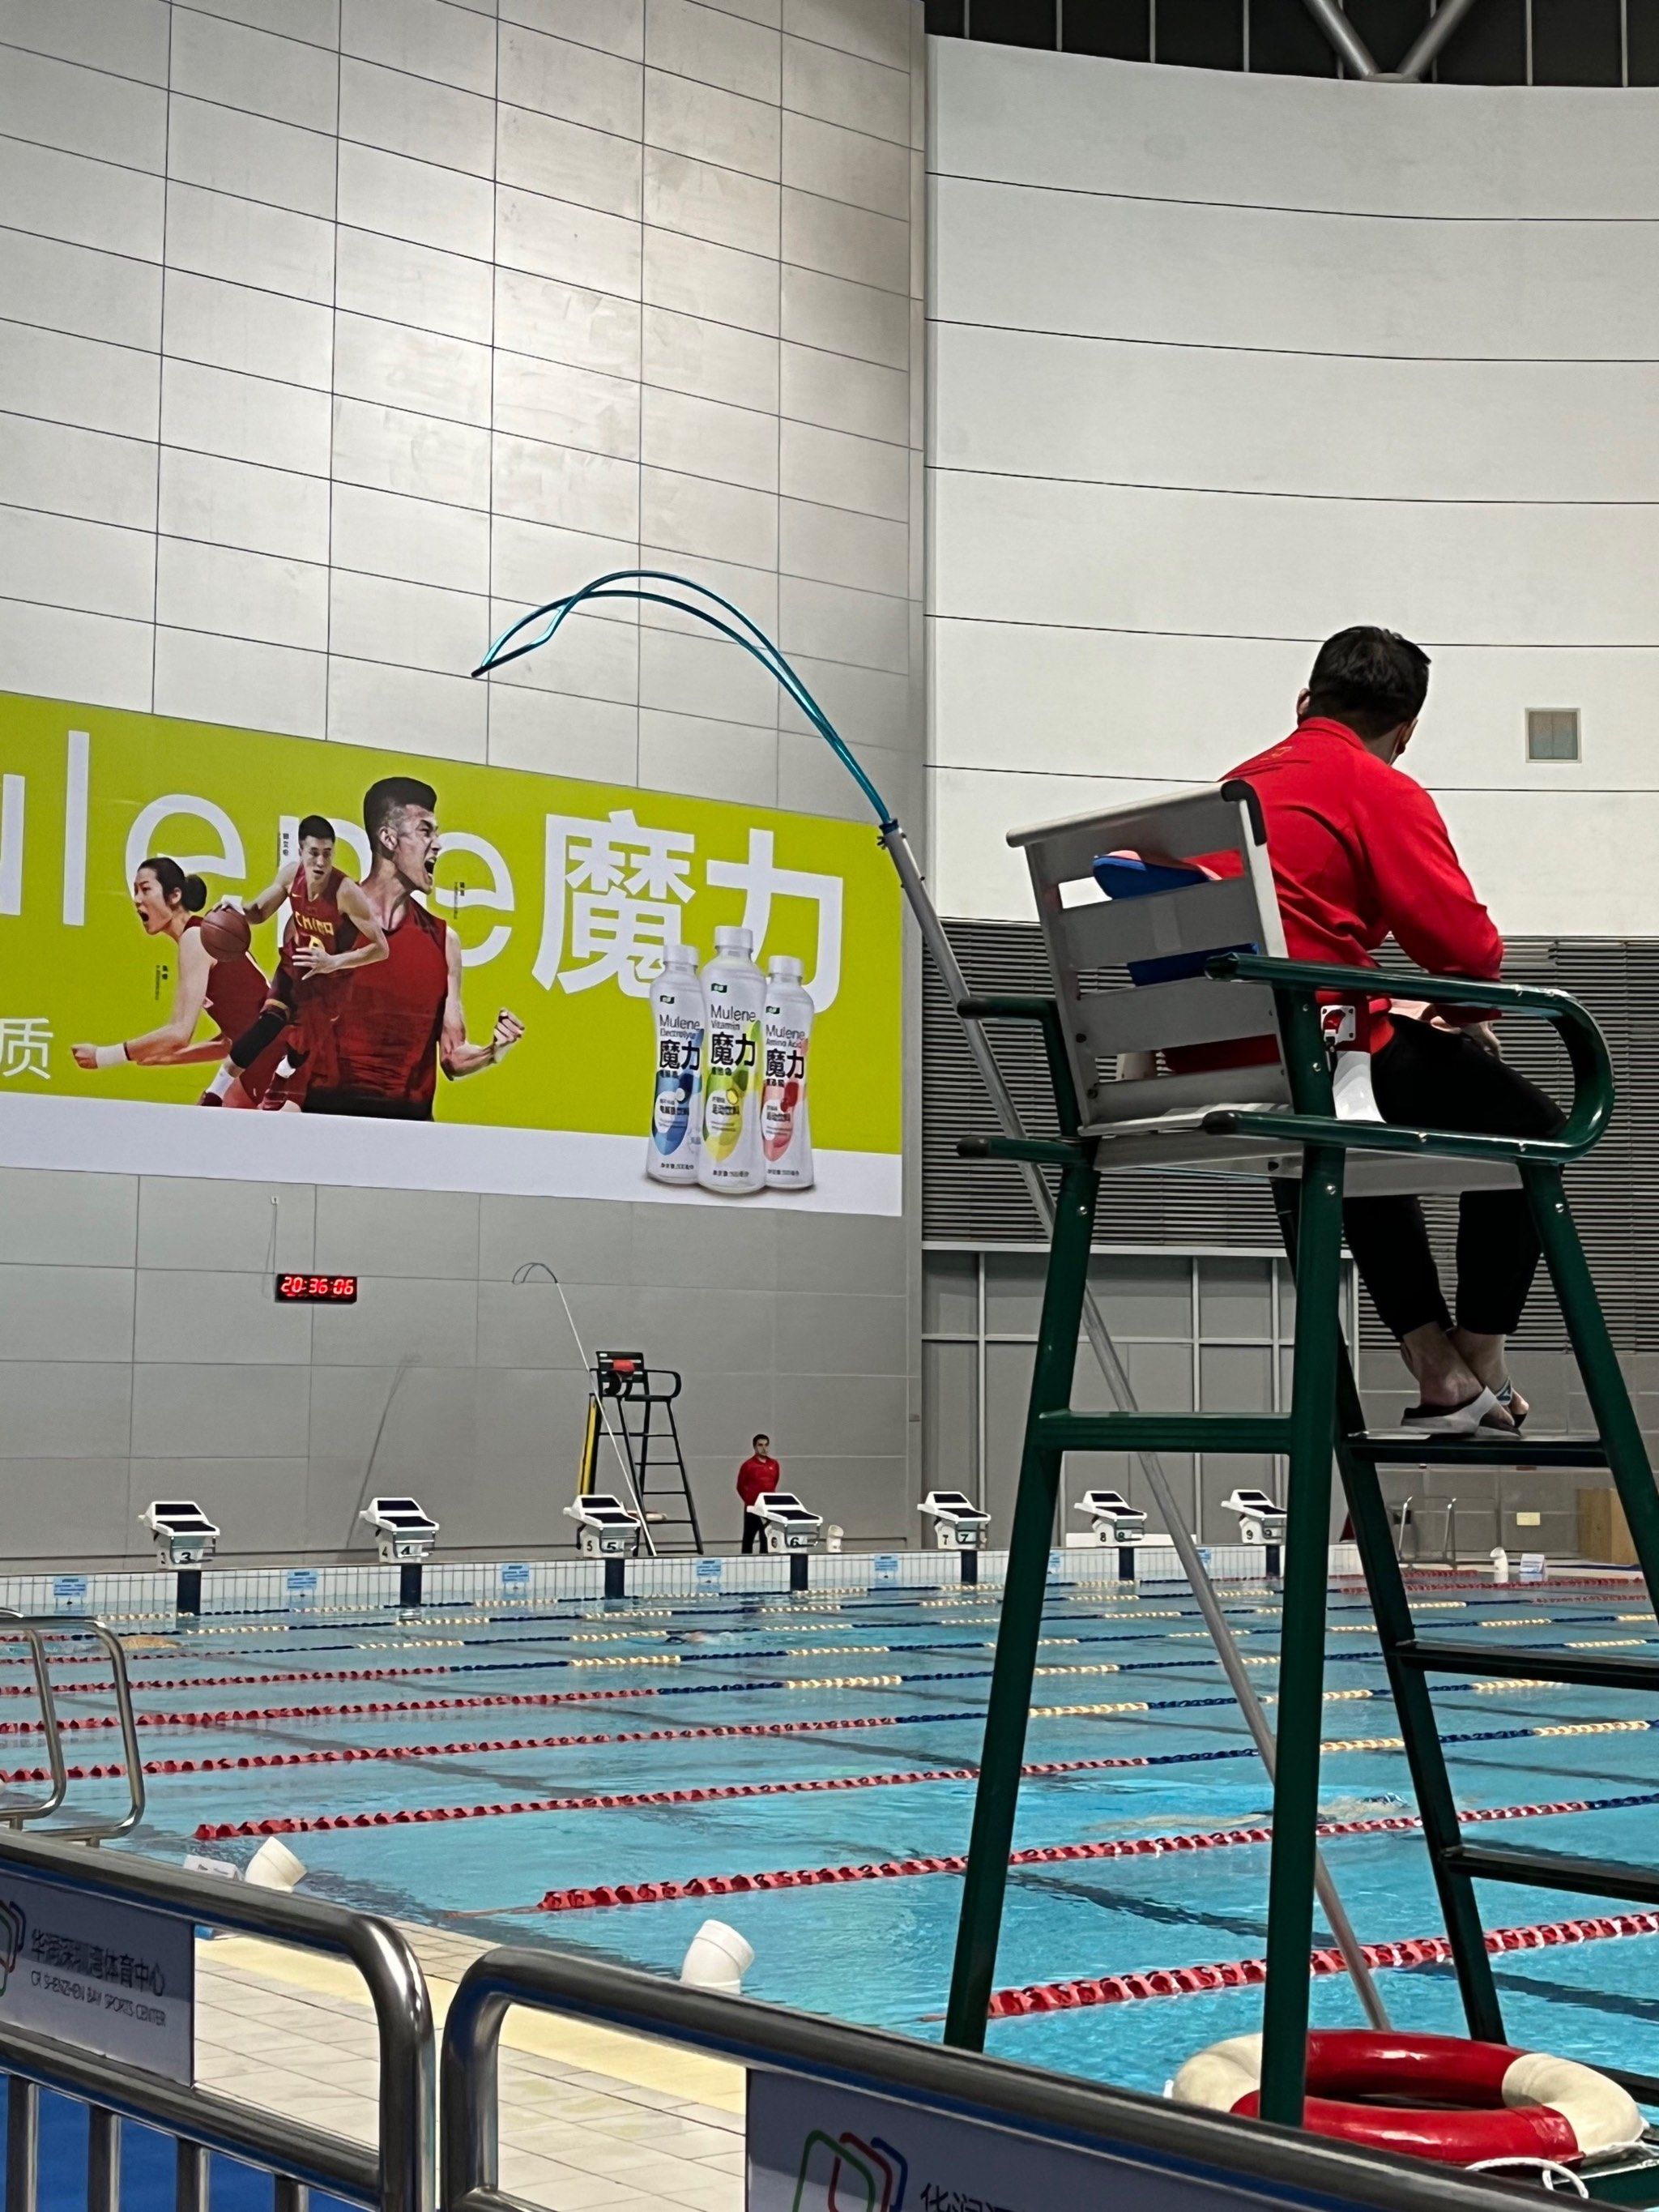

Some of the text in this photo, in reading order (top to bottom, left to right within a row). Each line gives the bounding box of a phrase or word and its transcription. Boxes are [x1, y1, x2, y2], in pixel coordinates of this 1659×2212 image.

[531, 809, 843, 1014] 魔力
[710, 1004, 757, 1023] Mulene
[659, 1014, 701, 1031] Mulene
[766, 1024, 805, 1040] Mulene
[659, 1040, 701, 1071] 魔力
[710, 1031, 756, 1066] 魔力
[766, 1048, 804, 1079] 魔力
[280, 1276, 354, 1295] 20:36:06
[790, 1537, 800, 1548] 6
[942, 1535, 949, 1545] 7
[960, 1534, 970, 1544] 7
[1100, 1532, 1107, 1543] 8
[400, 1545, 412, 1556] 4
[586, 1540, 593, 1552] 5
